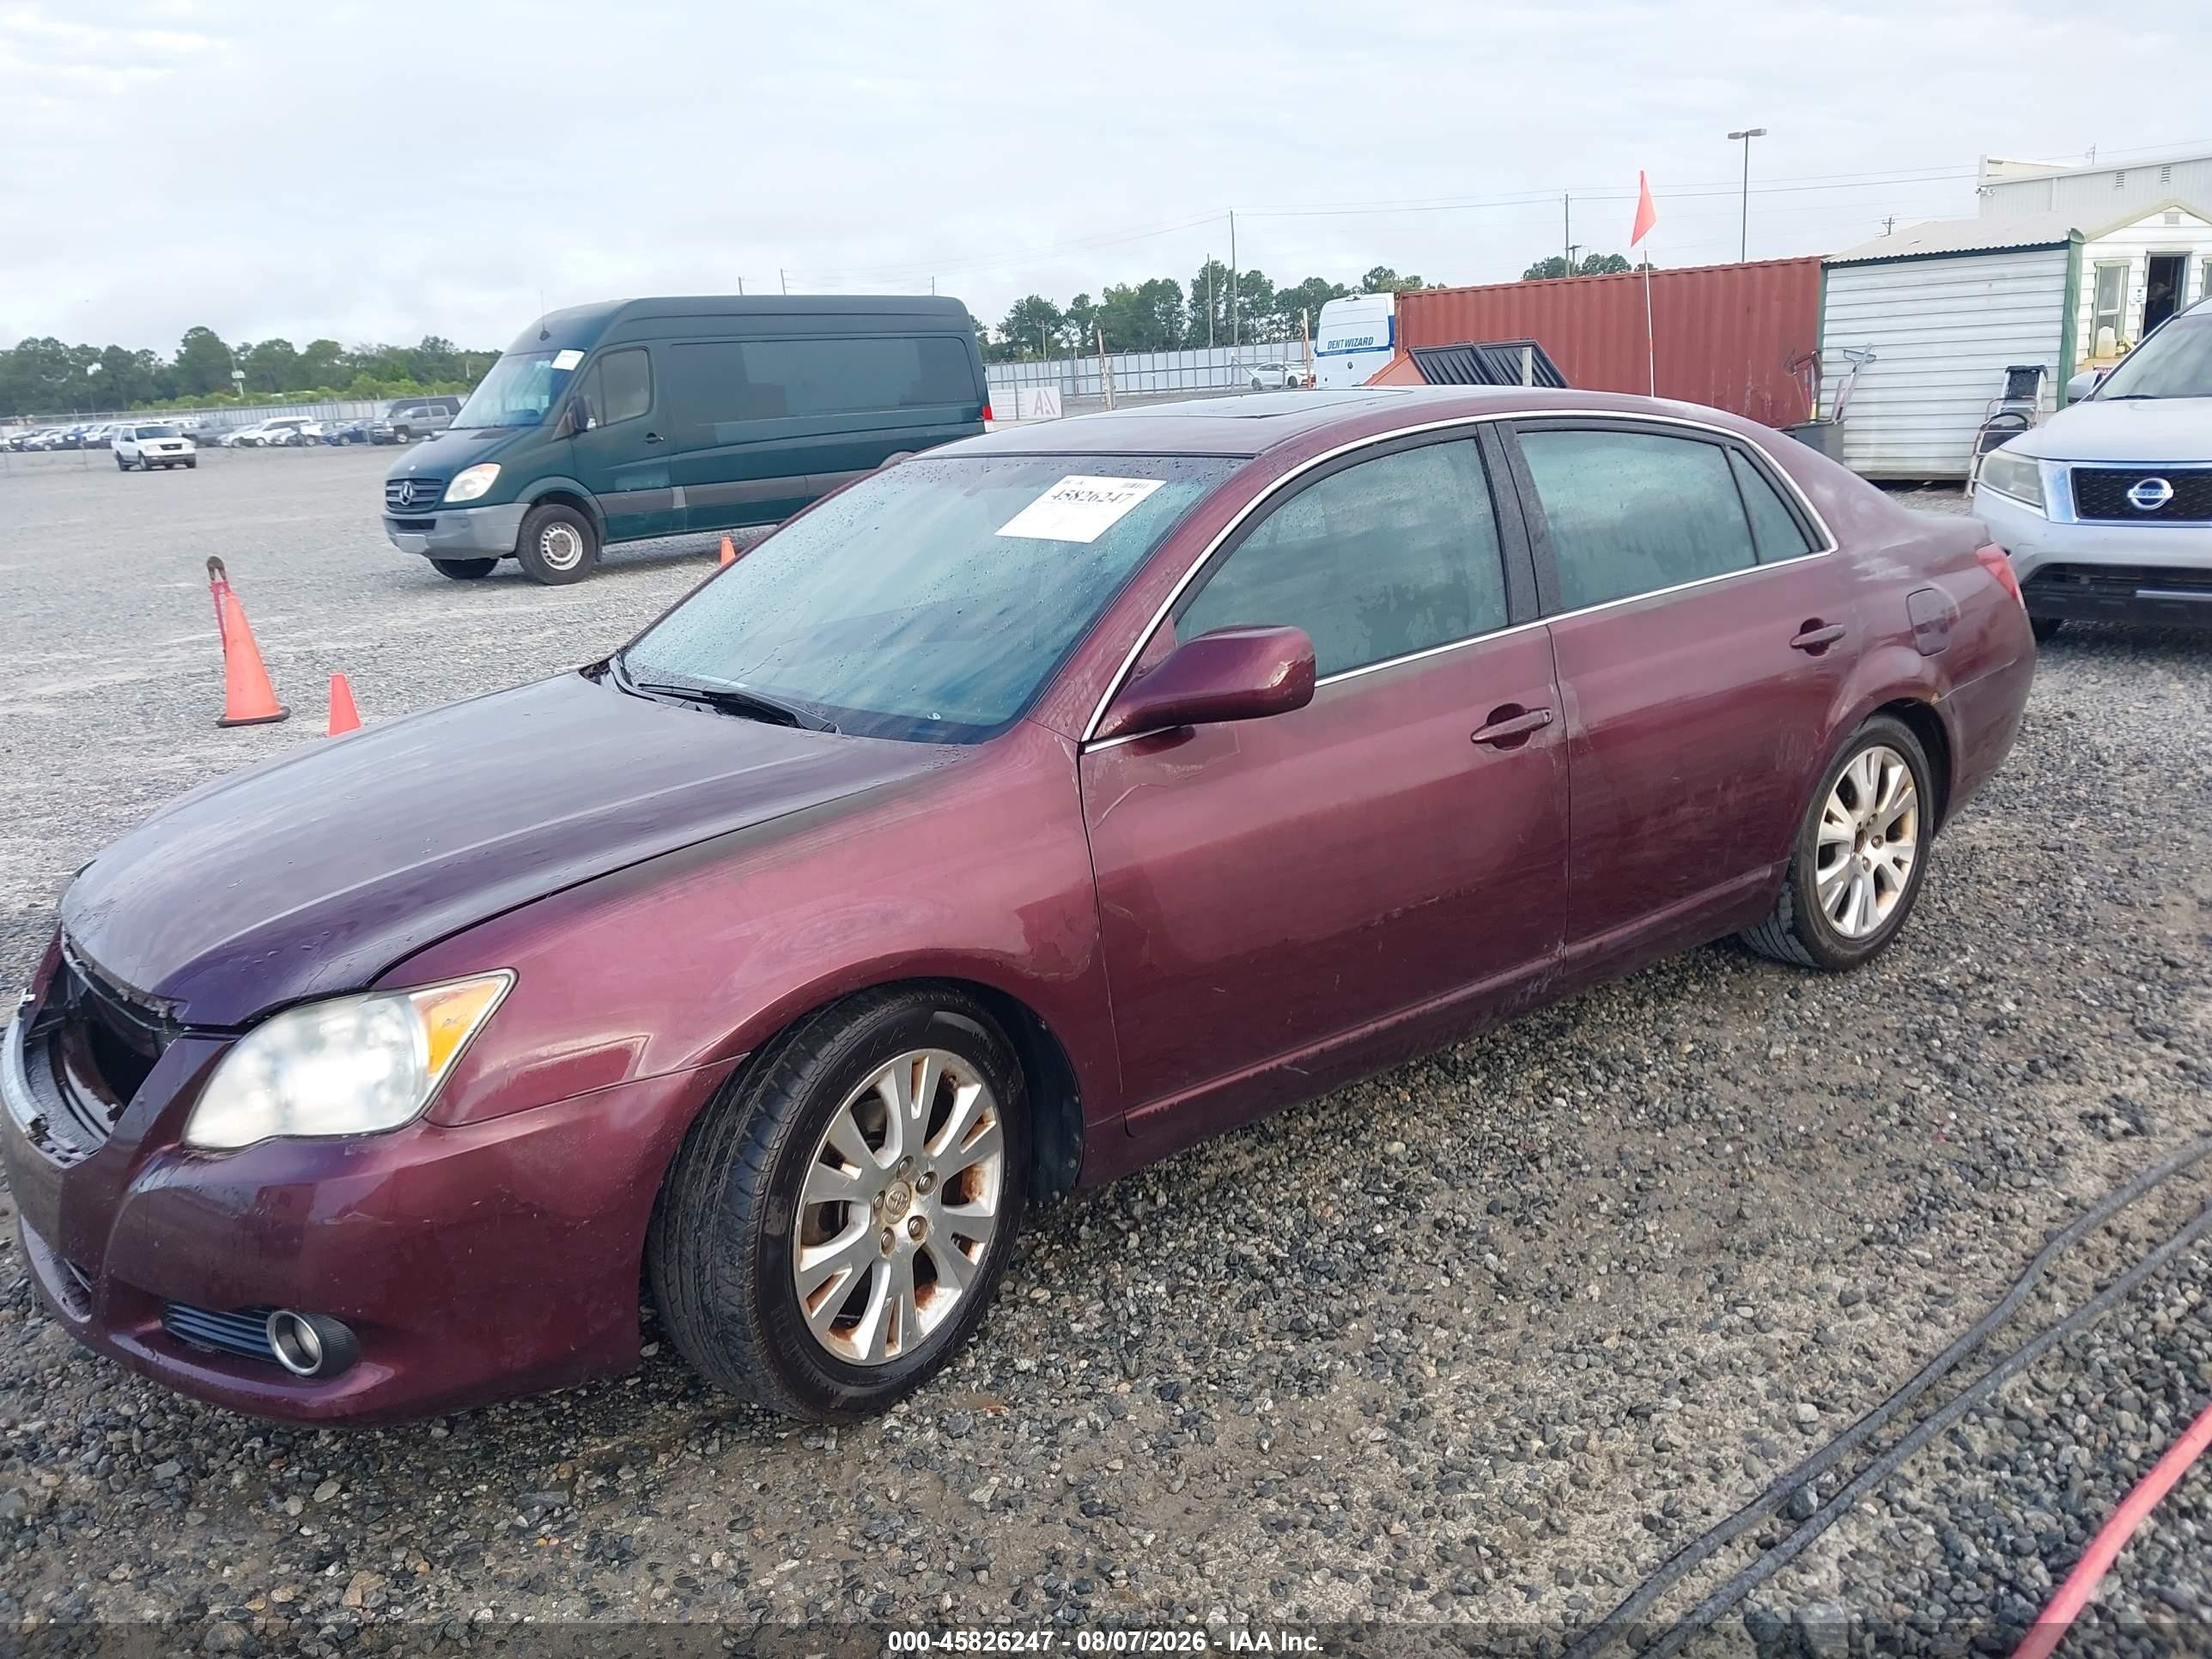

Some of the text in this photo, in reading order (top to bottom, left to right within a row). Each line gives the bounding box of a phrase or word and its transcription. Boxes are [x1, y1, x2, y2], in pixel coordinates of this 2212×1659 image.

[1328, 336, 1374, 349] DENT WIZARD
[1051, 489, 1136, 504] 45826247
